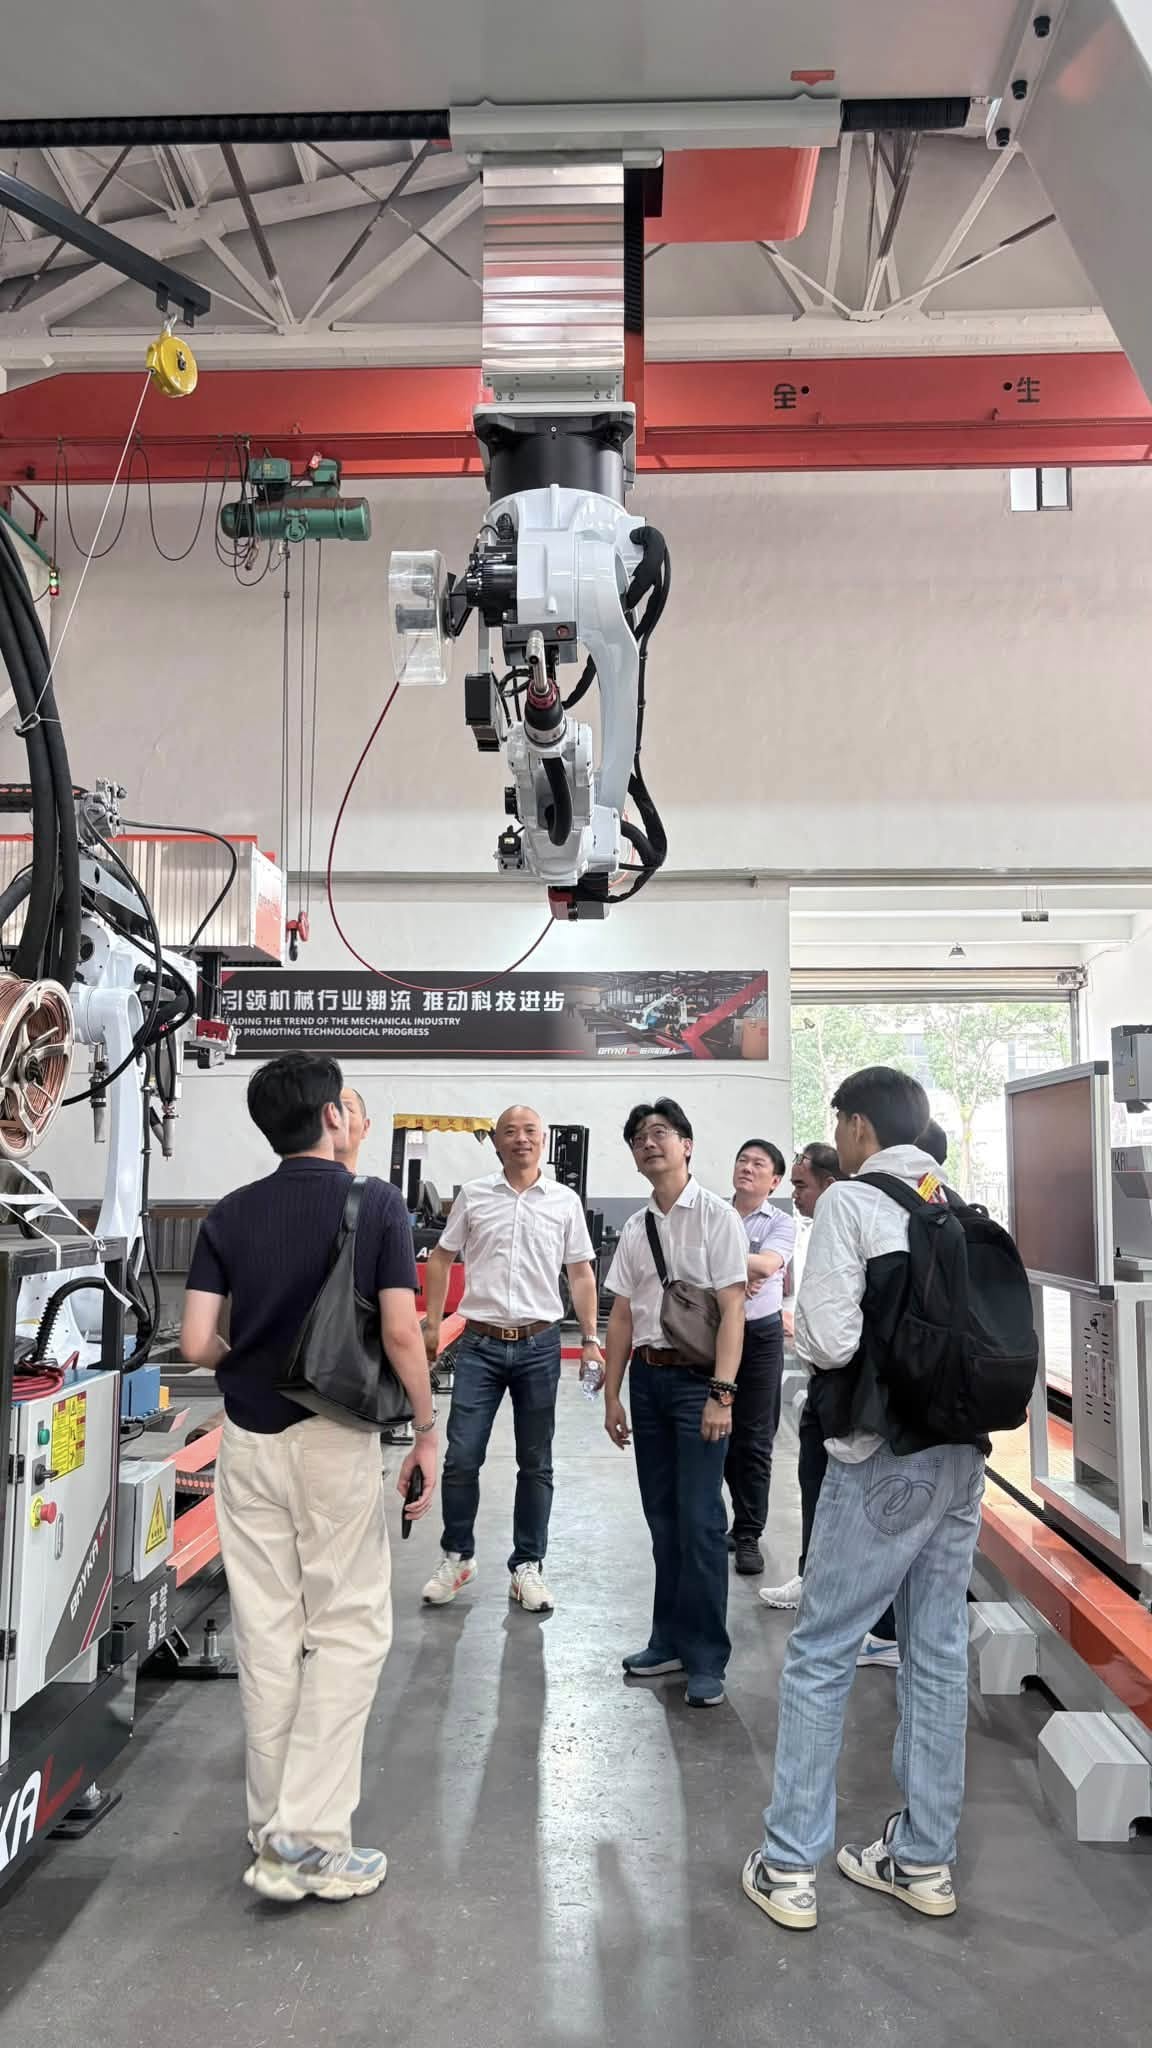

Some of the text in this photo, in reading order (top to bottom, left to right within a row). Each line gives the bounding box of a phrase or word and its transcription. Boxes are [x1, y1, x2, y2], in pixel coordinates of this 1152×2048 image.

[1016, 376, 1041, 404] 生
[222, 989, 565, 1012] 引领机械行业潮流 推动科技进步
[225, 1017, 461, 1026] EADING THE TREND OF THE MECHANICAL INDUSTRY
[244, 1028, 301, 1036] PROMOTING
[303, 1028, 380, 1036] TECHNOLOGICAL
[382, 1028, 430, 1036] PROGRESS
